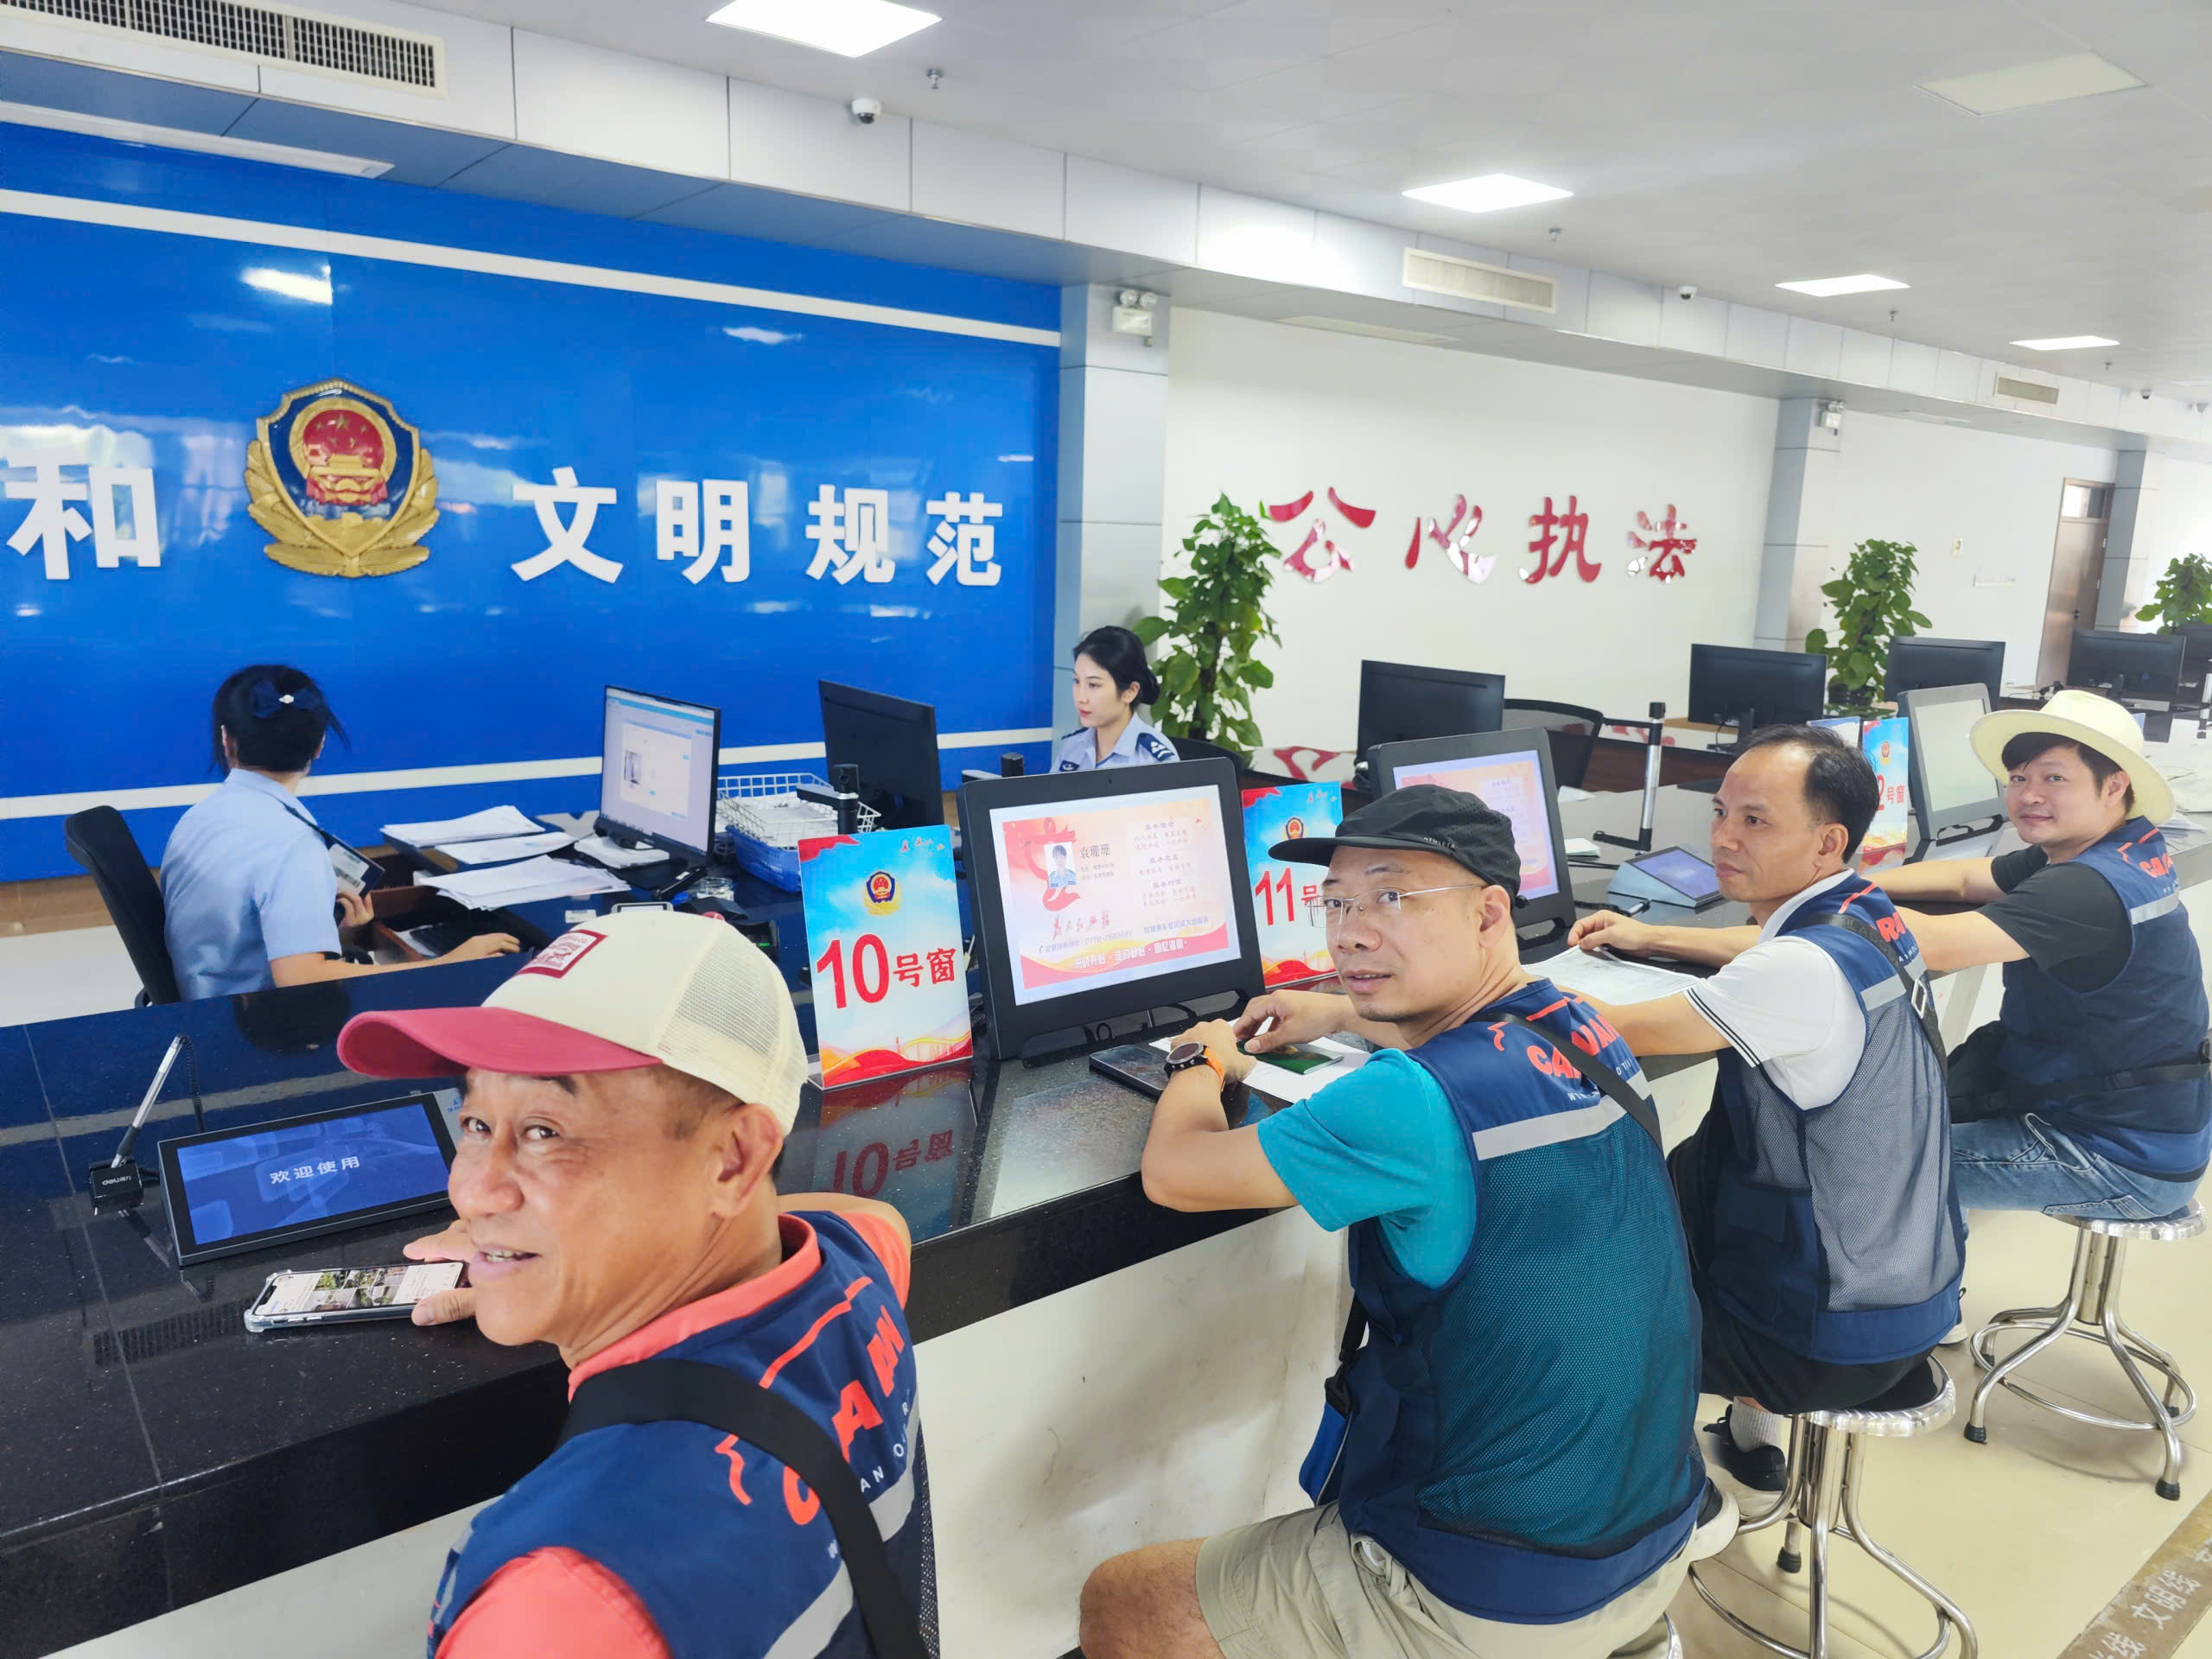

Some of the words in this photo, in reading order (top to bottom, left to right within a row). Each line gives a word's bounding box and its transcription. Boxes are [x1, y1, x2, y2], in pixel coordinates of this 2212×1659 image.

[5, 451, 162, 580] 和
[512, 467, 1003, 587] 文明规范
[1268, 486, 1698, 585] 公心执法
[1255, 868, 1325, 926] 11号
[816, 933, 957, 1009] 10号窗
[270, 1155, 359, 1185] 欢迎使用
[2130, 1569, 2202, 1631] 文明线
